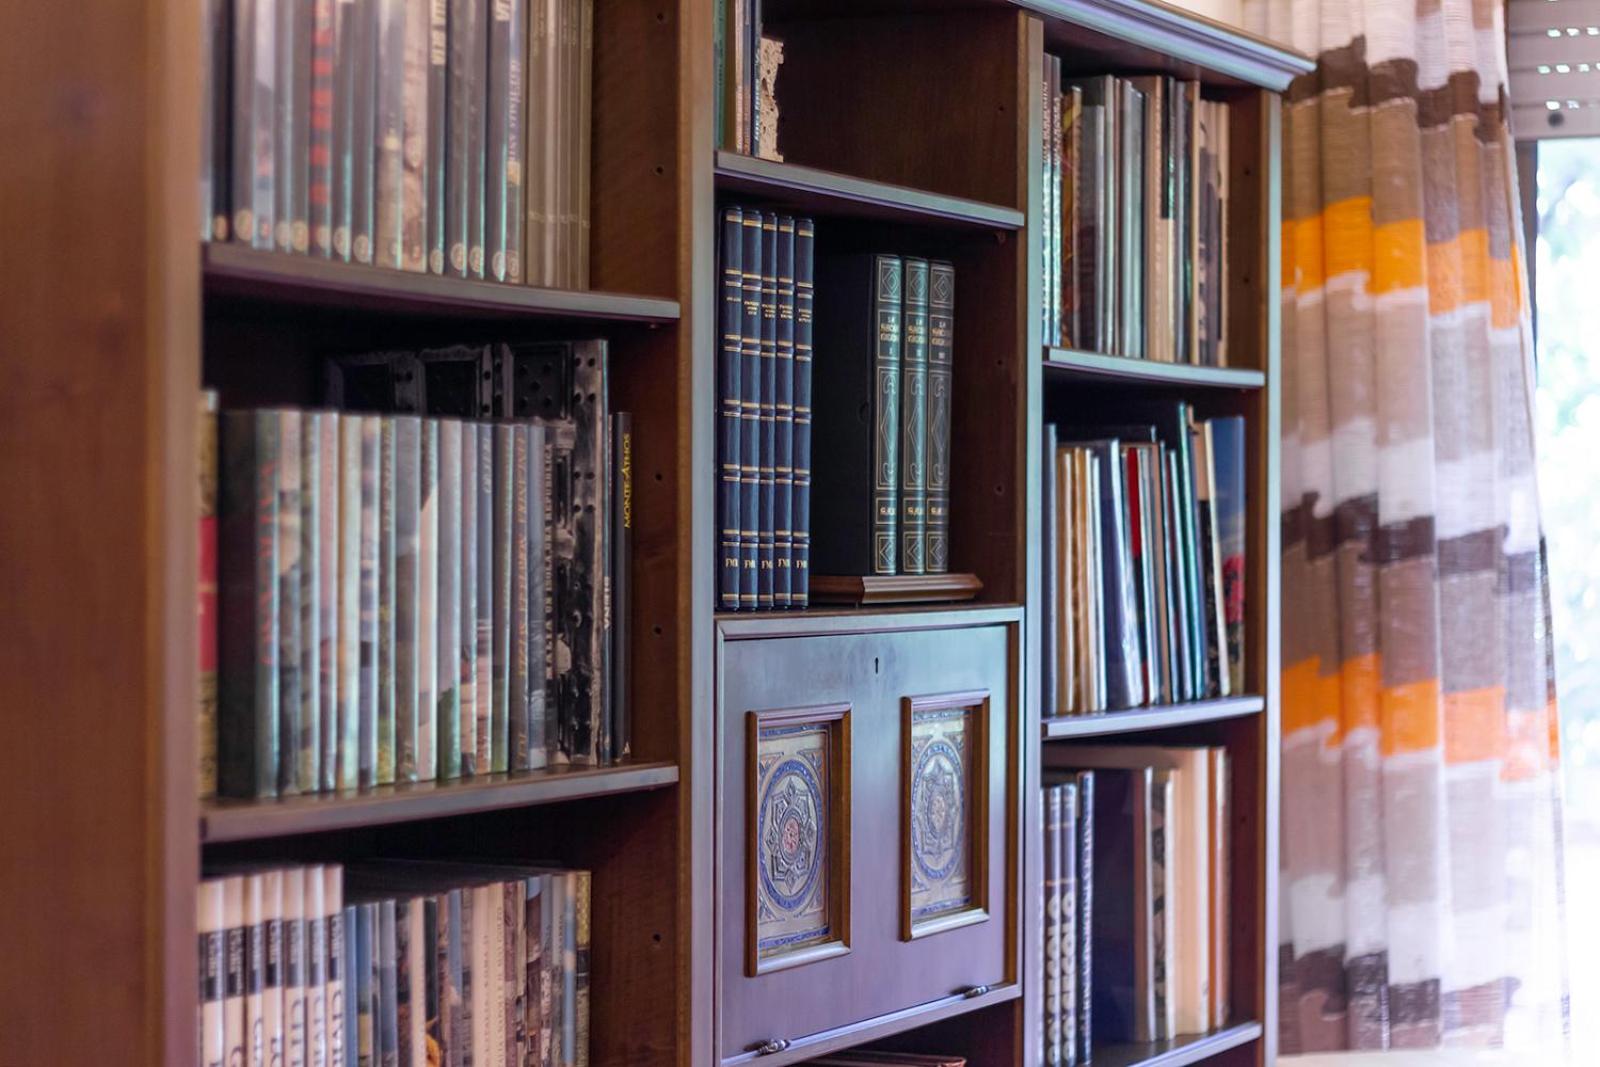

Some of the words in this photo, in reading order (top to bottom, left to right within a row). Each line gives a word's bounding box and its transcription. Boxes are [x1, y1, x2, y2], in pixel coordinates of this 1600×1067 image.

[544, 444, 552, 520] REPUBBLICA
[621, 433, 632, 479] ATHOS
[623, 480, 632, 528] MONTE
[545, 619, 553, 680] MALTA
